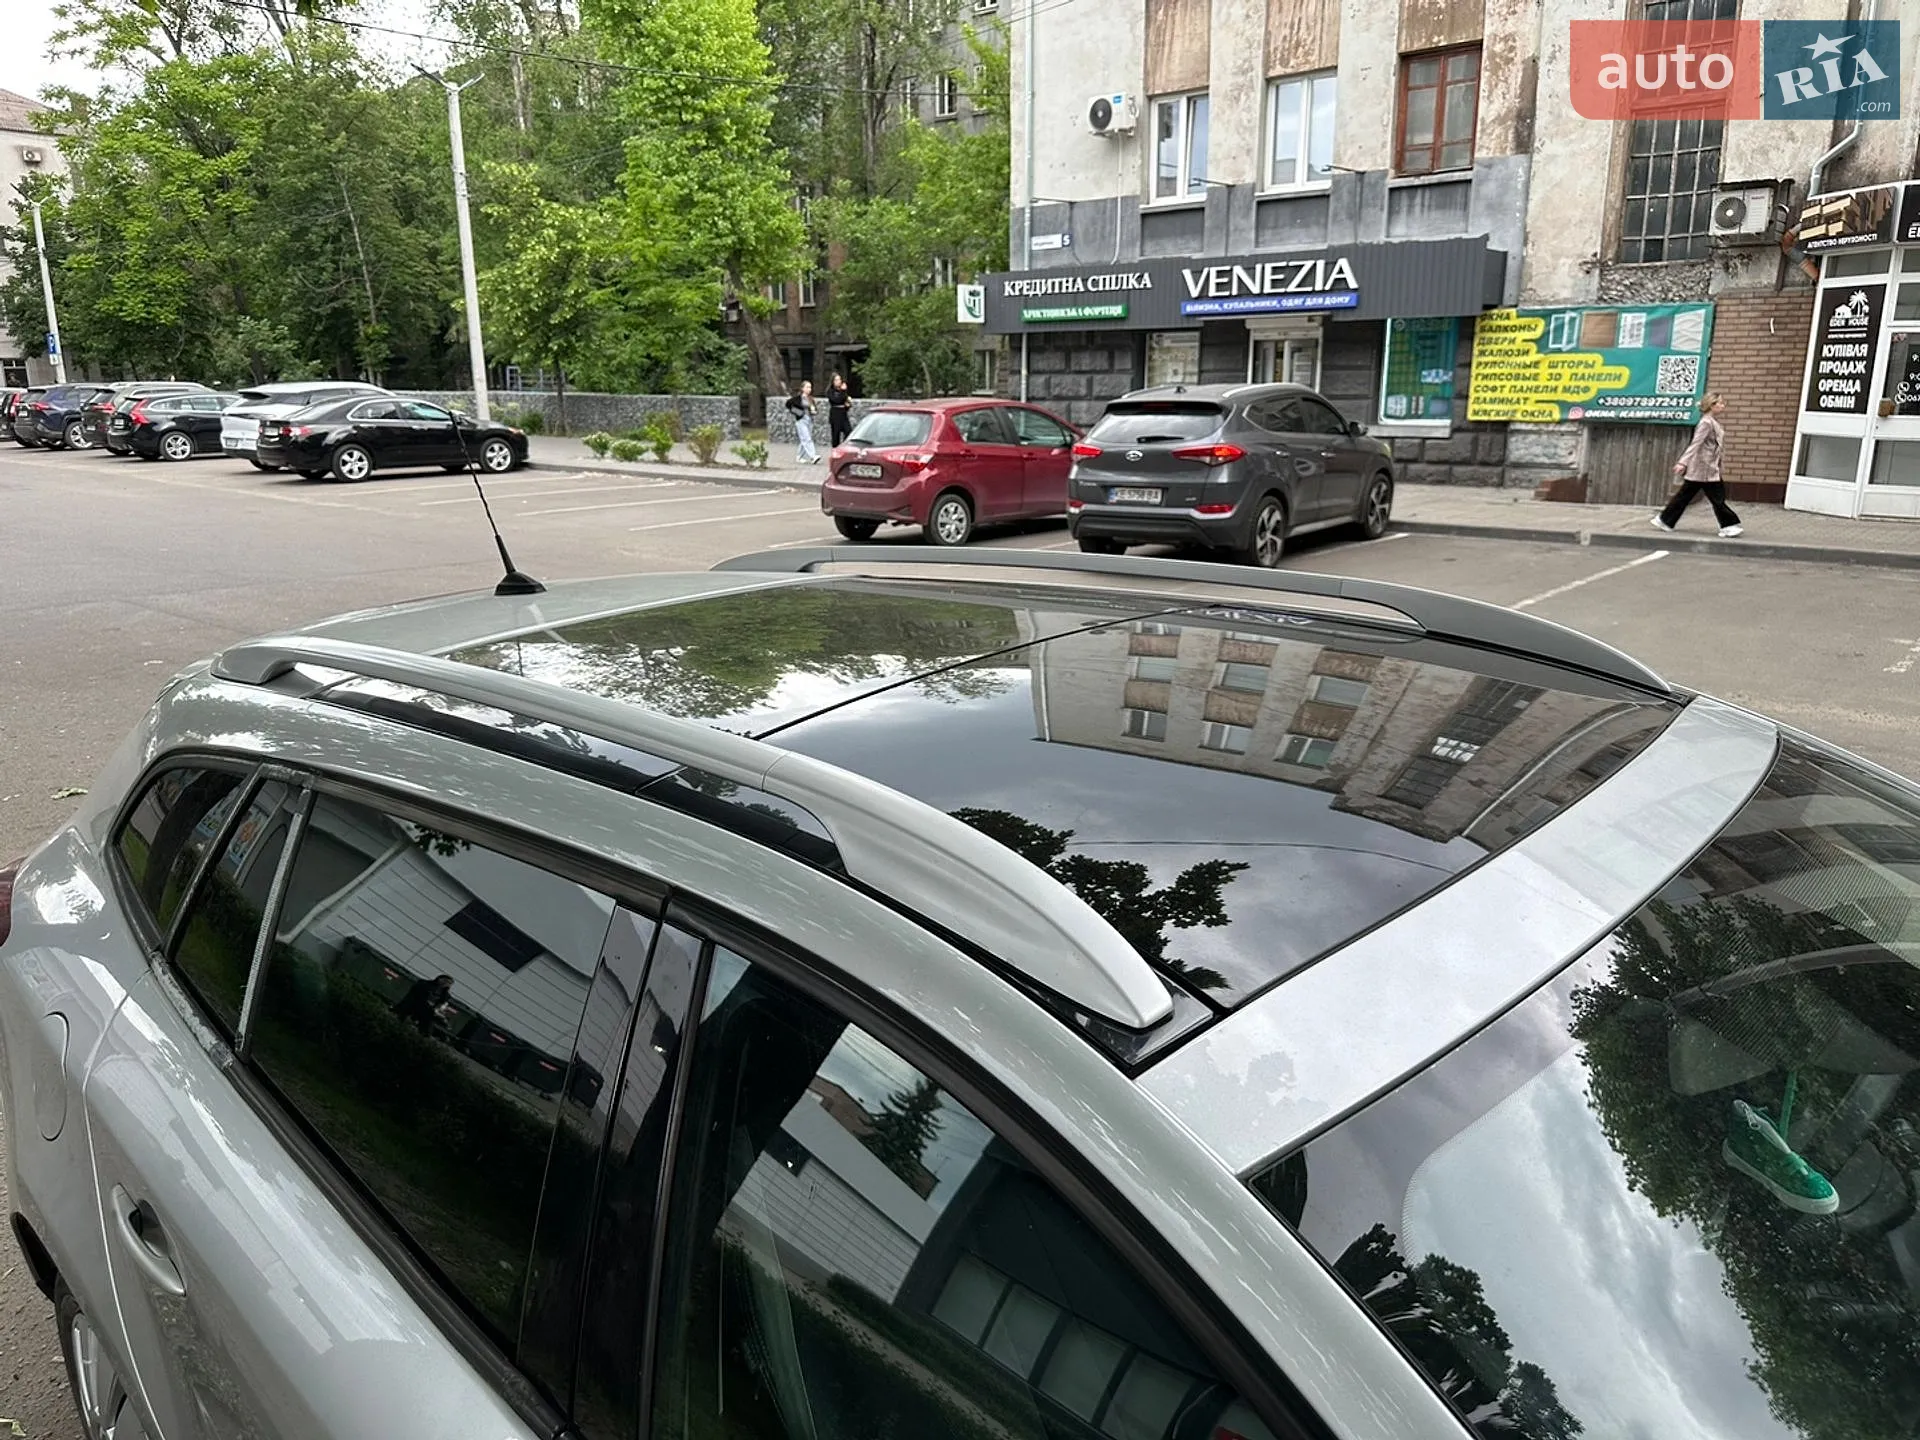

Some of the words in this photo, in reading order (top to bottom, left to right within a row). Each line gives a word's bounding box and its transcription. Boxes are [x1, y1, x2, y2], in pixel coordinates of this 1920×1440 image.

[1182, 258, 1359, 298] VENEZIA
[1004, 276, 1085, 298] КРЕДИТНА
[1087, 272, 1153, 292] СПІЛКА
[1480, 323, 1538, 334] БАЛКОНЫ
[1477, 336, 1517, 346] ДВЕРИ
[1477, 348, 1531, 357] ЖАЛЮЗИ
[1822, 344, 1868, 357] КУПІВЛЯ
[1475, 360, 1541, 370] РУЛОННЫЕ
[1547, 360, 1596, 369] ШТОРЫ
[1819, 360, 1866, 376] ПРОДАЖ
[1474, 372, 1540, 382] ГИПСОВЫЕ
[1547, 372, 1562, 382] 3D
[1569, 372, 1622, 382] ПАНЕЛИ
[1473, 385, 1506, 394] СОФТ
[1508, 385, 1558, 394] ПАНЕЛИ
[1561, 384, 1591, 395] МДФ
[1818, 379, 1861, 394] ОРЕНДА
[1471, 396, 1530, 405] ЛАМИНАТ
[1820, 395, 1855, 408] ОБМІН
[1471, 409, 1517, 418] МЯГКИЕ
[1521, 409, 1553, 418] ОКНА
